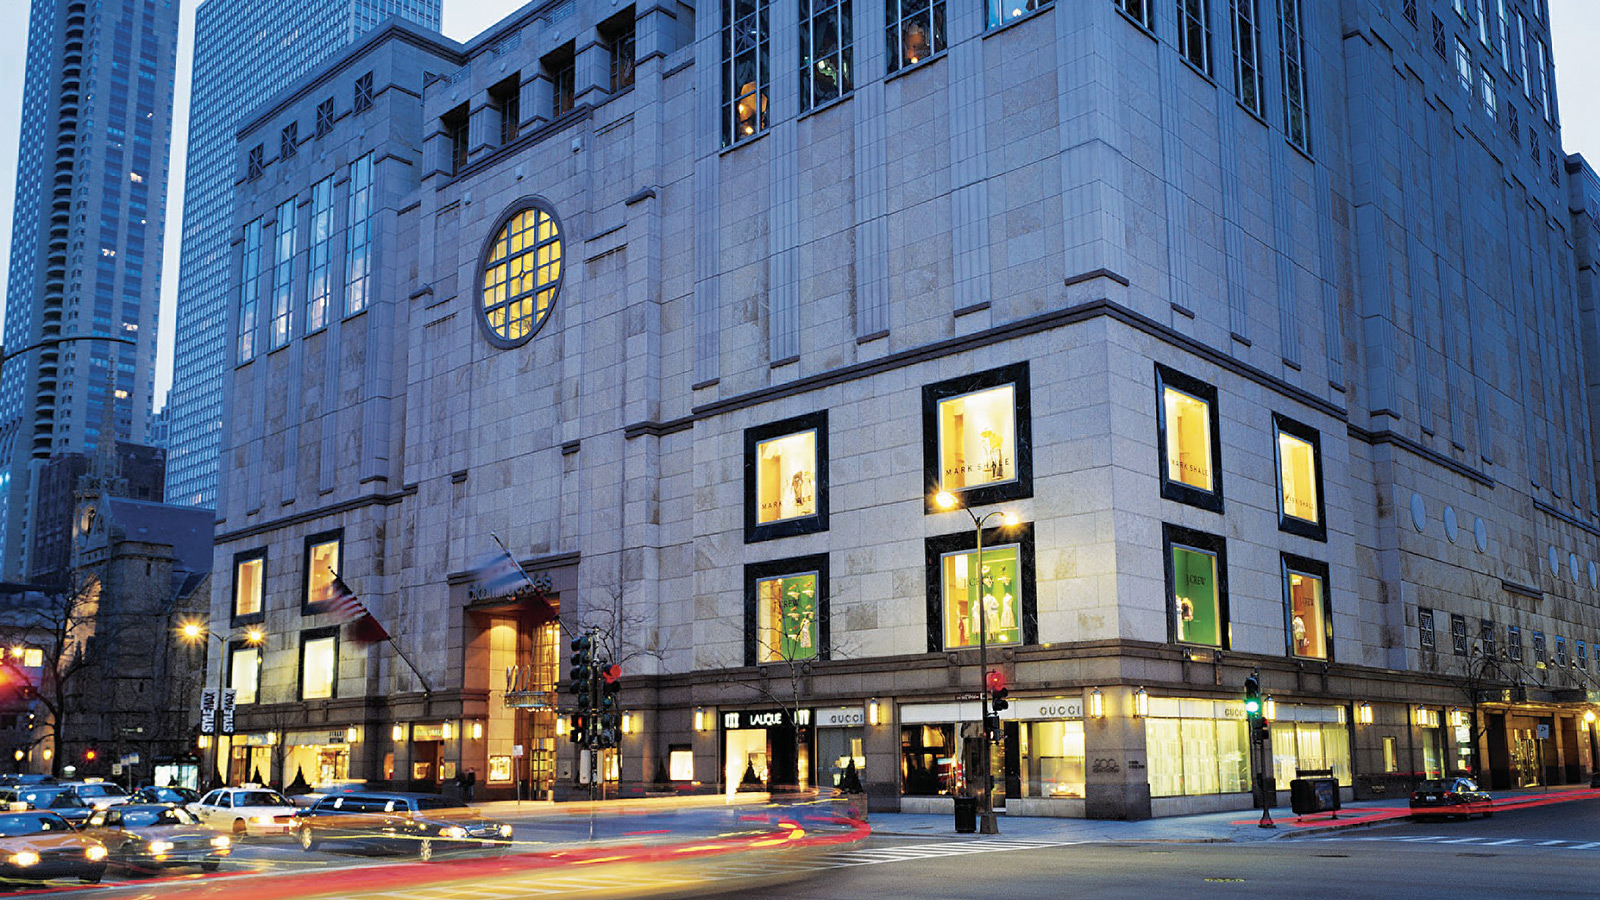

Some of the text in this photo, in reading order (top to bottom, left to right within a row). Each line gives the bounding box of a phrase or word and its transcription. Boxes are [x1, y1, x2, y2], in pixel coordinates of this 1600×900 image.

[946, 465, 973, 476] MARK
[201, 692, 216, 733] STYLEMAX
[223, 692, 236, 733] STYLEMAX
[1040, 705, 1081, 717] GUCCI
[1225, 708, 1244, 718] GUCC
[830, 713, 864, 724] GUCCI
